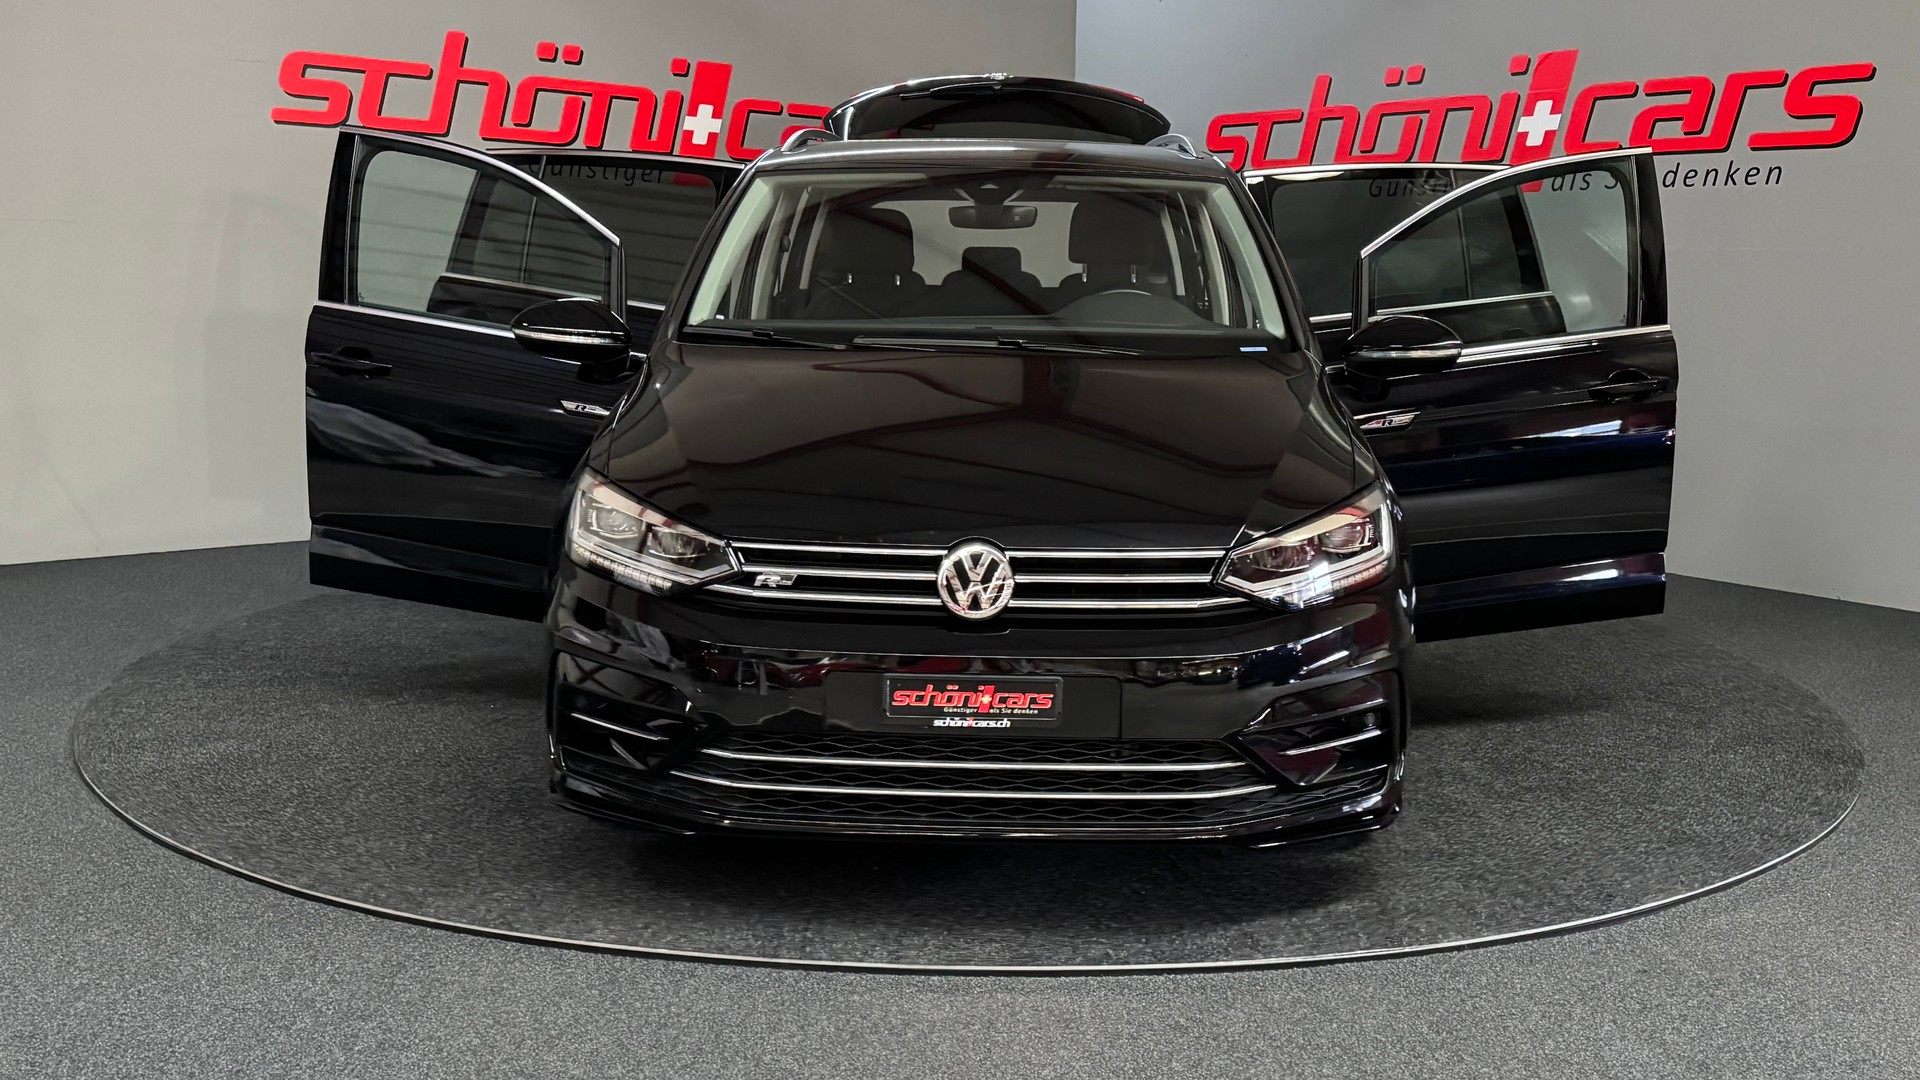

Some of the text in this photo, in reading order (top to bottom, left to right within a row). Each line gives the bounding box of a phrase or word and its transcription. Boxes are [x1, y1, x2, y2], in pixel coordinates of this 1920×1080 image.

[1662, 160, 1783, 188] denken
[989, 706, 1000, 714] als
[1013, 707, 1039, 715] denken
